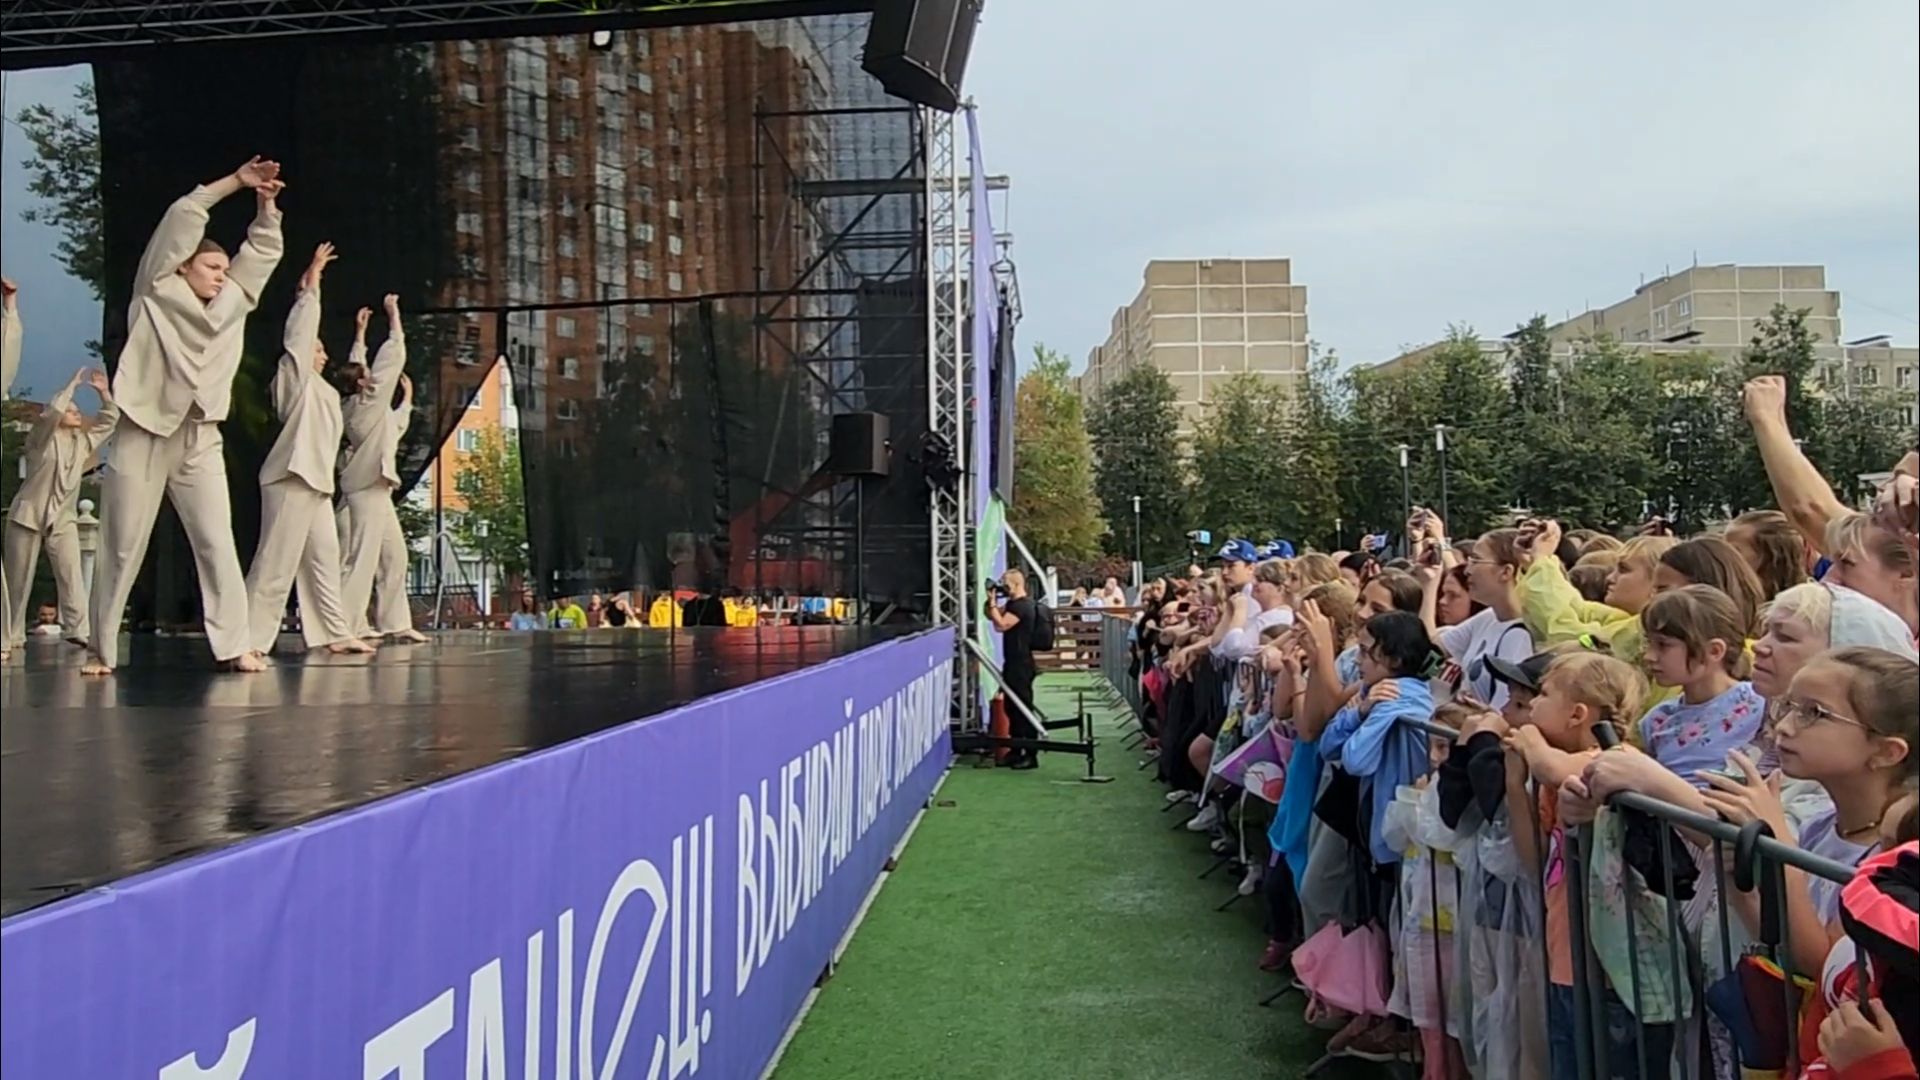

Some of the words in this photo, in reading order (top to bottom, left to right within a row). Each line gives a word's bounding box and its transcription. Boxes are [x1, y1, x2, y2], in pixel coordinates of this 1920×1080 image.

[363, 815, 713, 1080] НЕЦ!
[736, 698, 855, 997] ВЫБИРАЙ
[856, 696, 893, 840] ПАРК!
